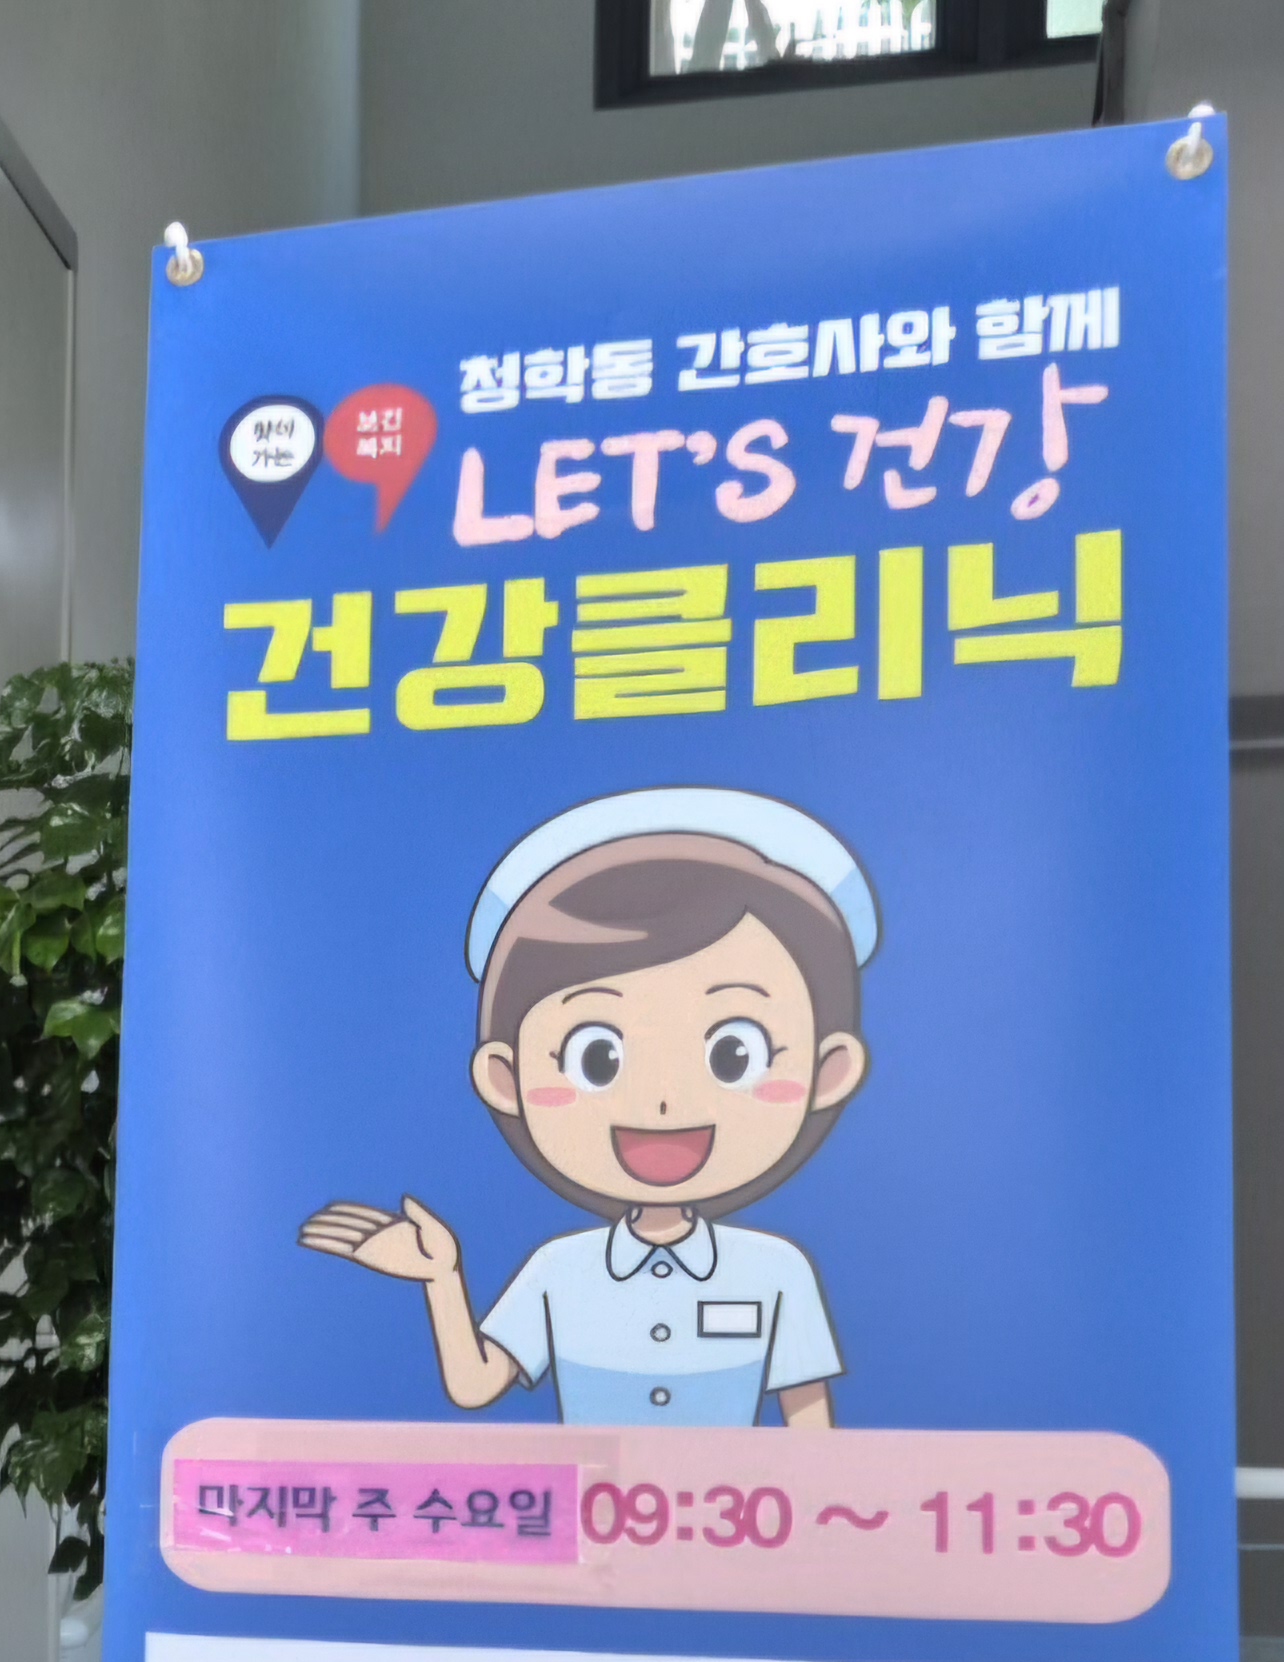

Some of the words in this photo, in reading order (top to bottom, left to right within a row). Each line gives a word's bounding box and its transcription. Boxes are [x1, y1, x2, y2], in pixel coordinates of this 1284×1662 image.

[458, 339, 654, 415] 청학동
[675, 305, 955, 392] 간호사와
[976, 285, 1121, 362] 함께
[831, 362, 1109, 521] 건강
[223, 528, 1124, 741] 건강클리닉
[198, 1484, 336, 1533] 마지막
[352, 1487, 397, 1532] 주
[413, 1488, 553, 1537] 수요일
[579, 1480, 794, 1550] 09:30
[919, 1490, 1142, 1559] 11:30
